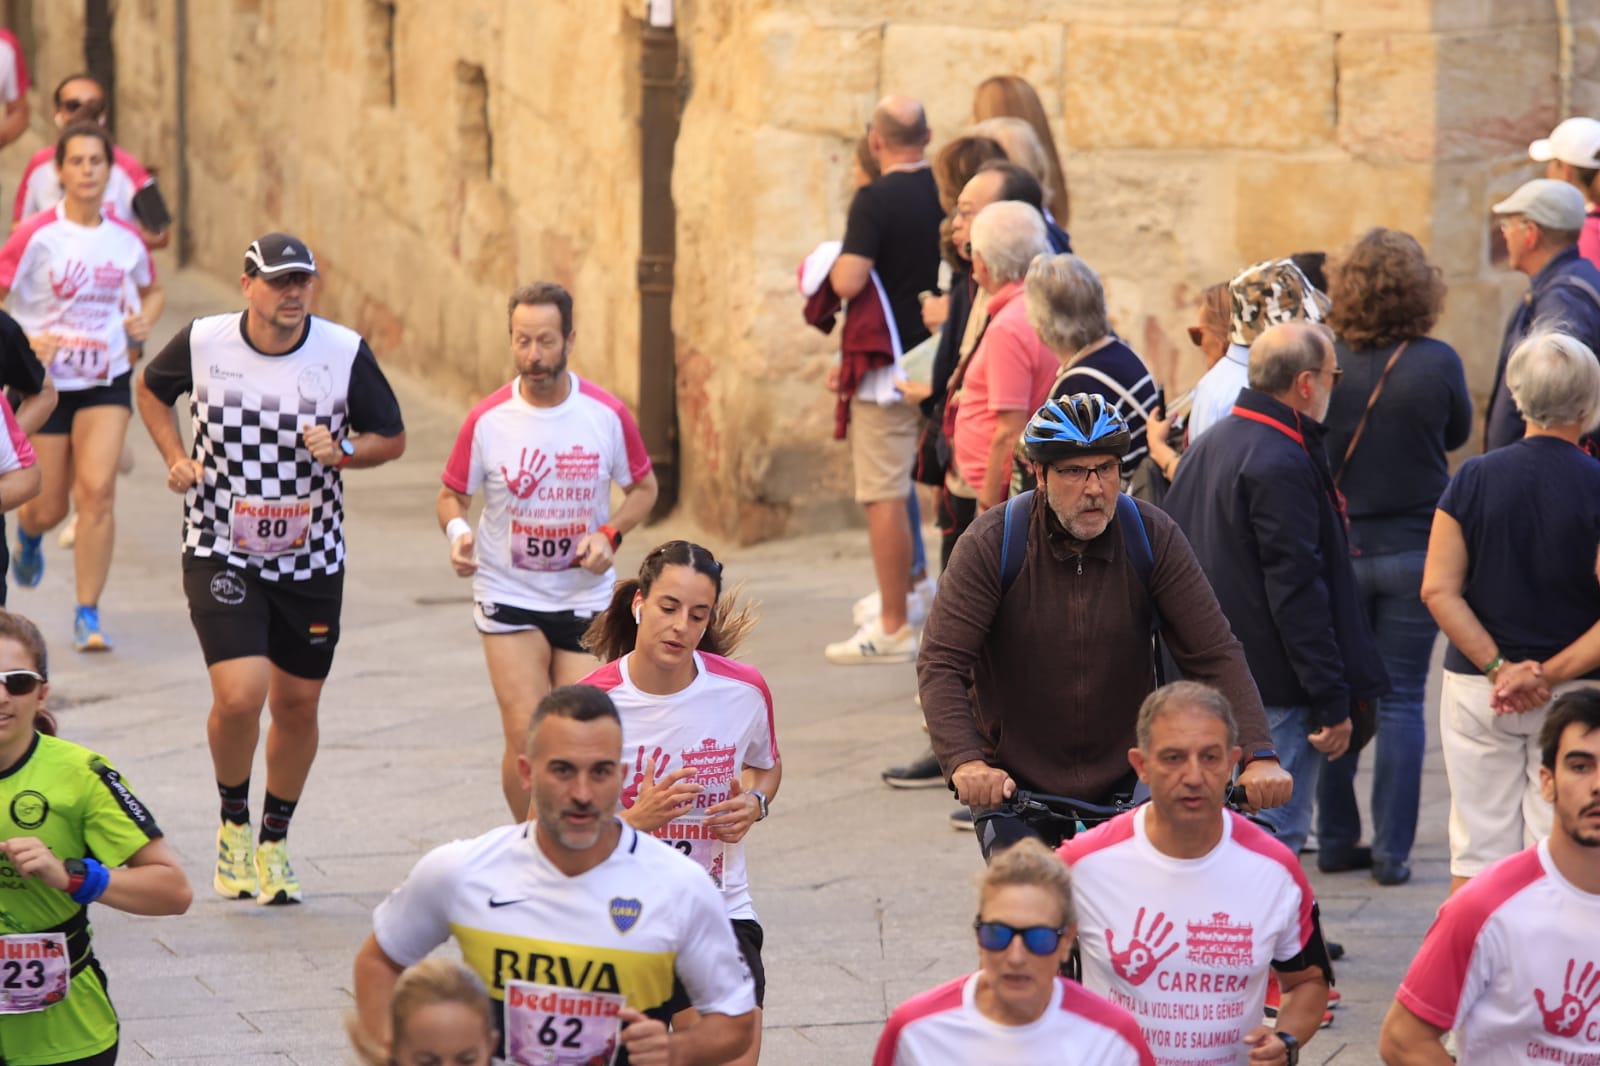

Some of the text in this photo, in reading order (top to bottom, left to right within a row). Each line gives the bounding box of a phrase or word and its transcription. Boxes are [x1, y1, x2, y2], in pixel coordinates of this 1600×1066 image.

[63, 349, 99, 368] 211
[257, 519, 288, 539] 80
[511, 520, 587, 537] bedunia
[526, 536, 572, 557] 509
[3, 960, 45, 989] 23
[493, 948, 622, 996] BBVA
[1158, 970, 1249, 993] CARRERA
[509, 986, 621, 1018] bedunia
[1138, 1000, 1149, 1016] LA
[1151, 1001, 1200, 1021] VIOLENCIA
[1202, 1004, 1214, 1021] DE
[537, 1016, 583, 1049] 62
[1174, 1031, 1188, 1049] DE
[1190, 1028, 1240, 1049] SALAMANCA
[1526, 1042, 1561, 1062] CONTRA
